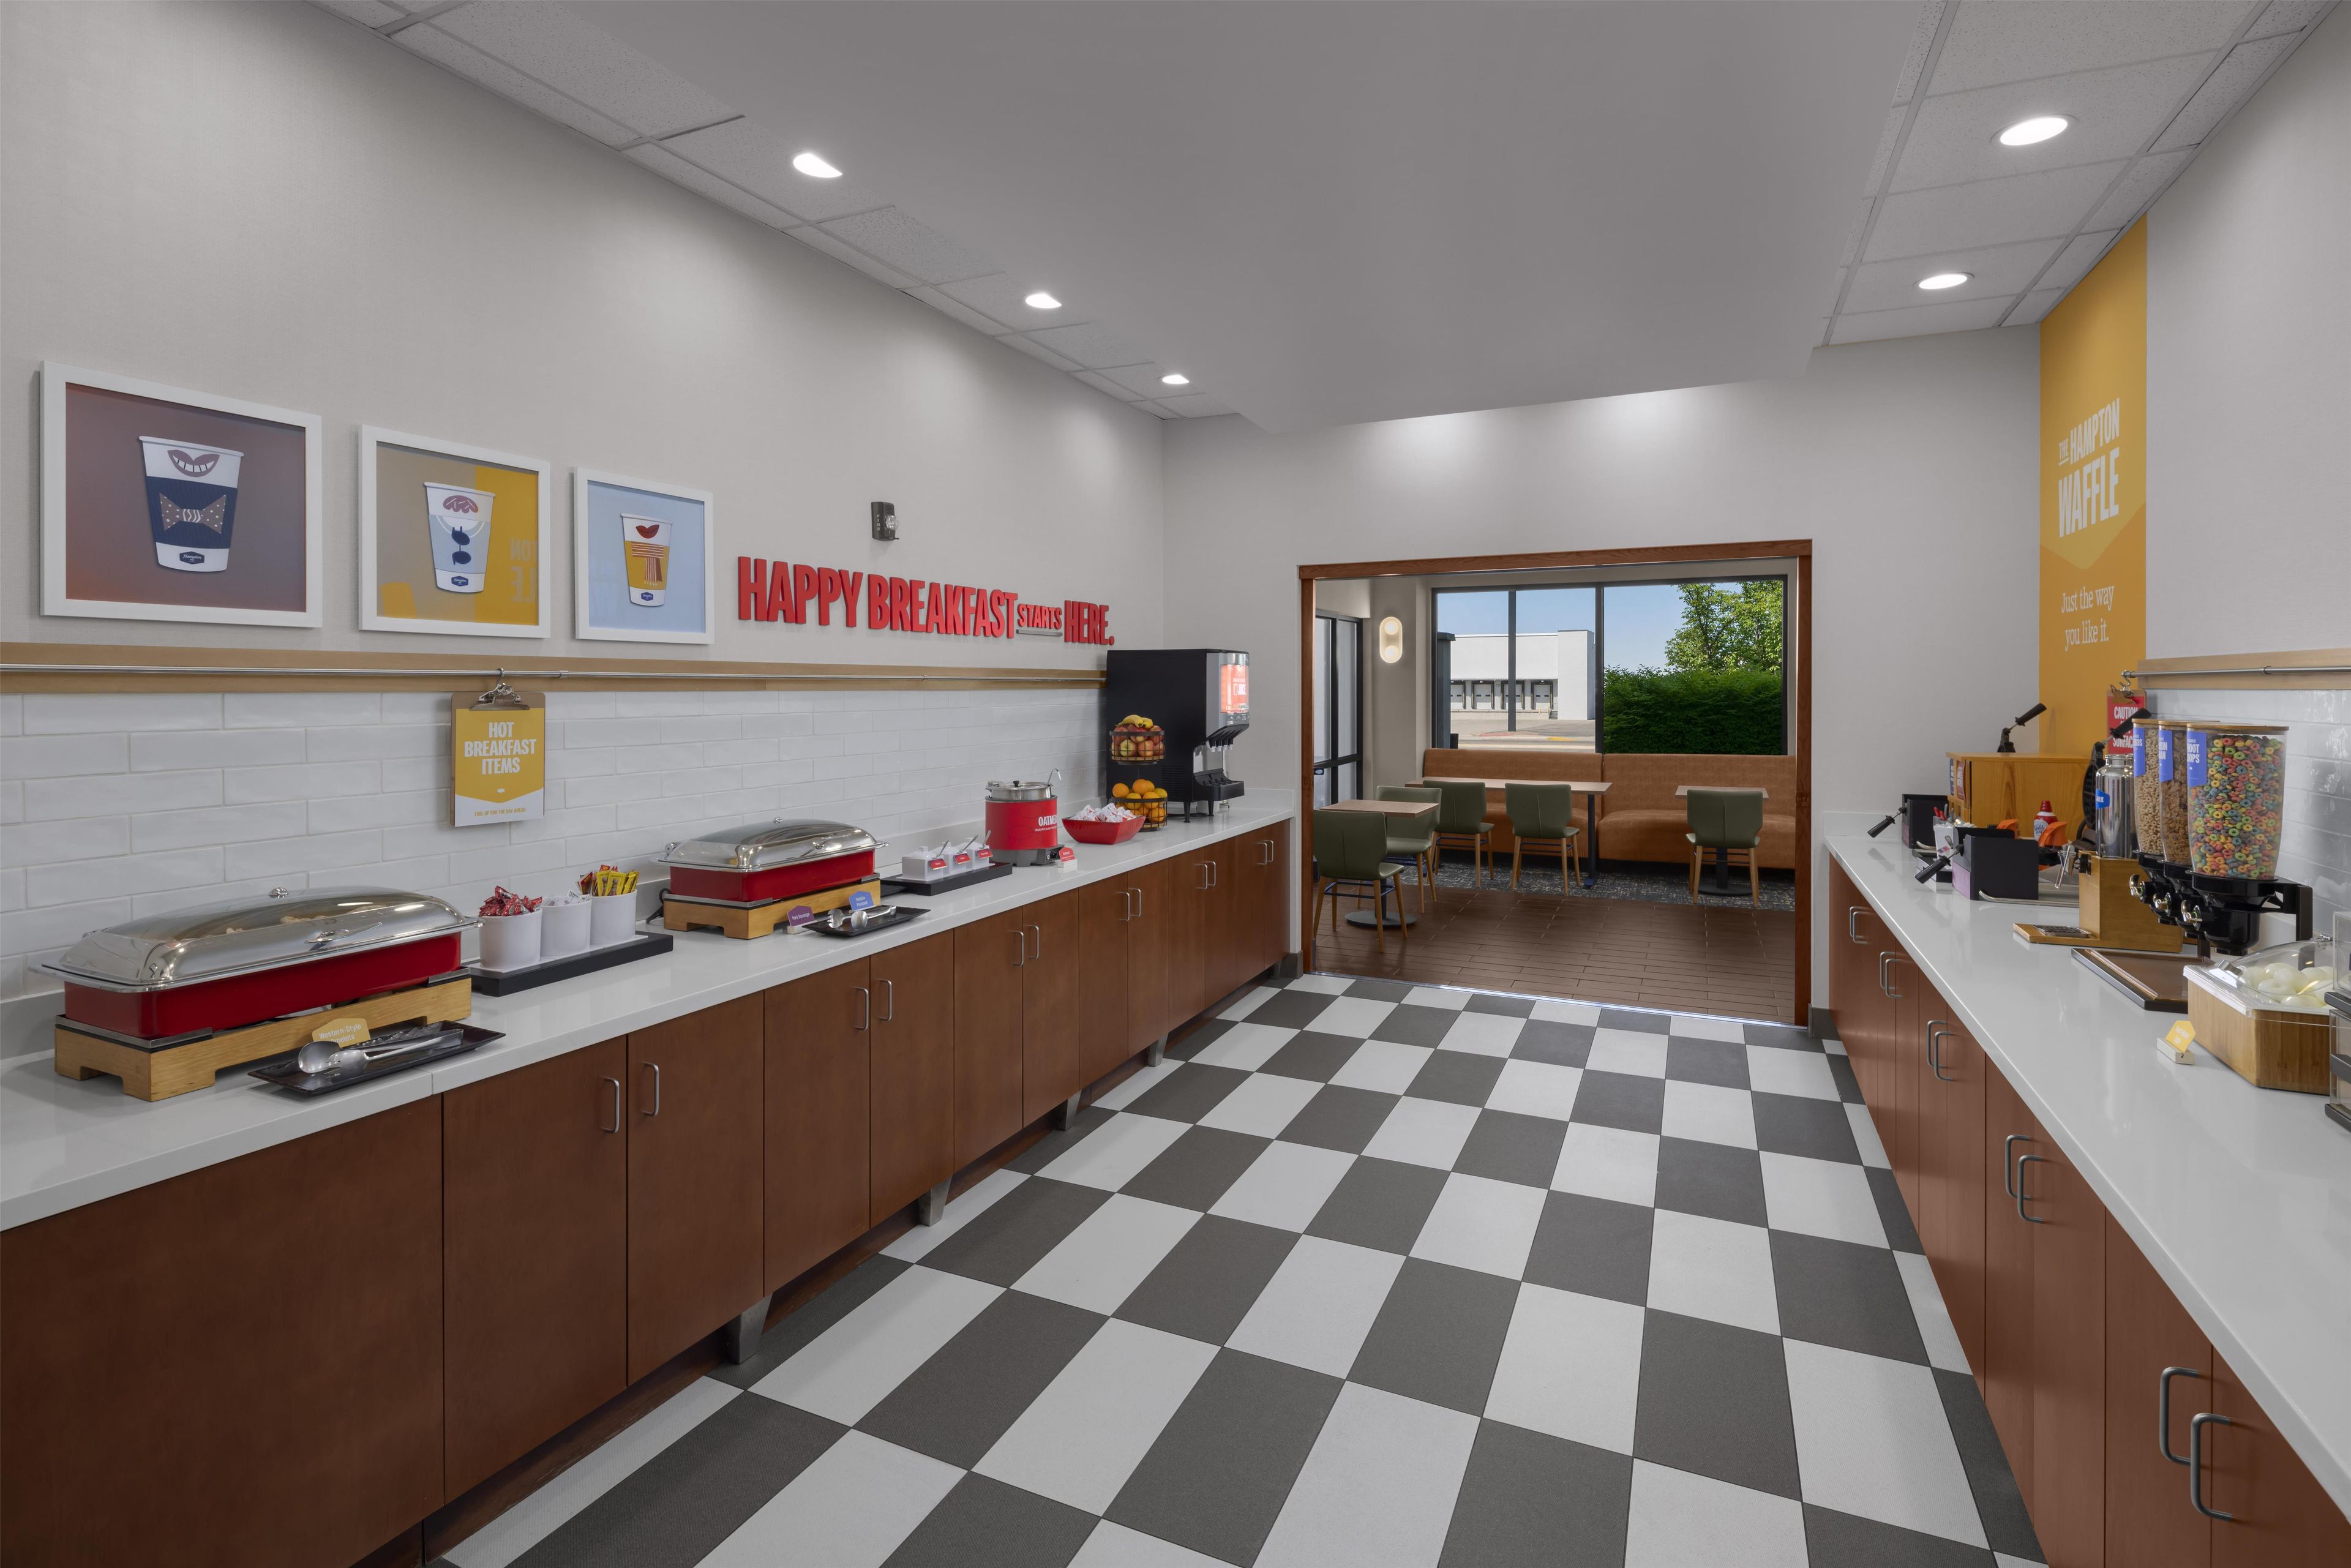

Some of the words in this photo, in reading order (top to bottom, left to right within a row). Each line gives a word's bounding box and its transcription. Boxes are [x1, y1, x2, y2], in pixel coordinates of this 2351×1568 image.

[2058, 437, 2069, 460] THE
[2069, 397, 2120, 465] HAMPTON
[2058, 446, 2120, 538] WAFFLE
[738, 556, 864, 628] HAPPY
[868, 573, 1018, 639] BREAKFAST
[1018, 603, 1063, 629] STARTS
[1064, 599, 1116, 645] HERE.
[2061, 591, 2079, 613] Just
[2080, 585, 2094, 609] the
[2095, 584, 2115, 612] way
[2064, 626, 2080, 651] you
[2082, 621, 2098, 644] like
[2100, 618, 2109, 642] it.
[489, 722, 514, 738] HOT
[464, 739, 536, 757] BREAKFAST
[482, 758, 520, 775] ITEMS
[319, 1024, 362, 1039] Western-Style
